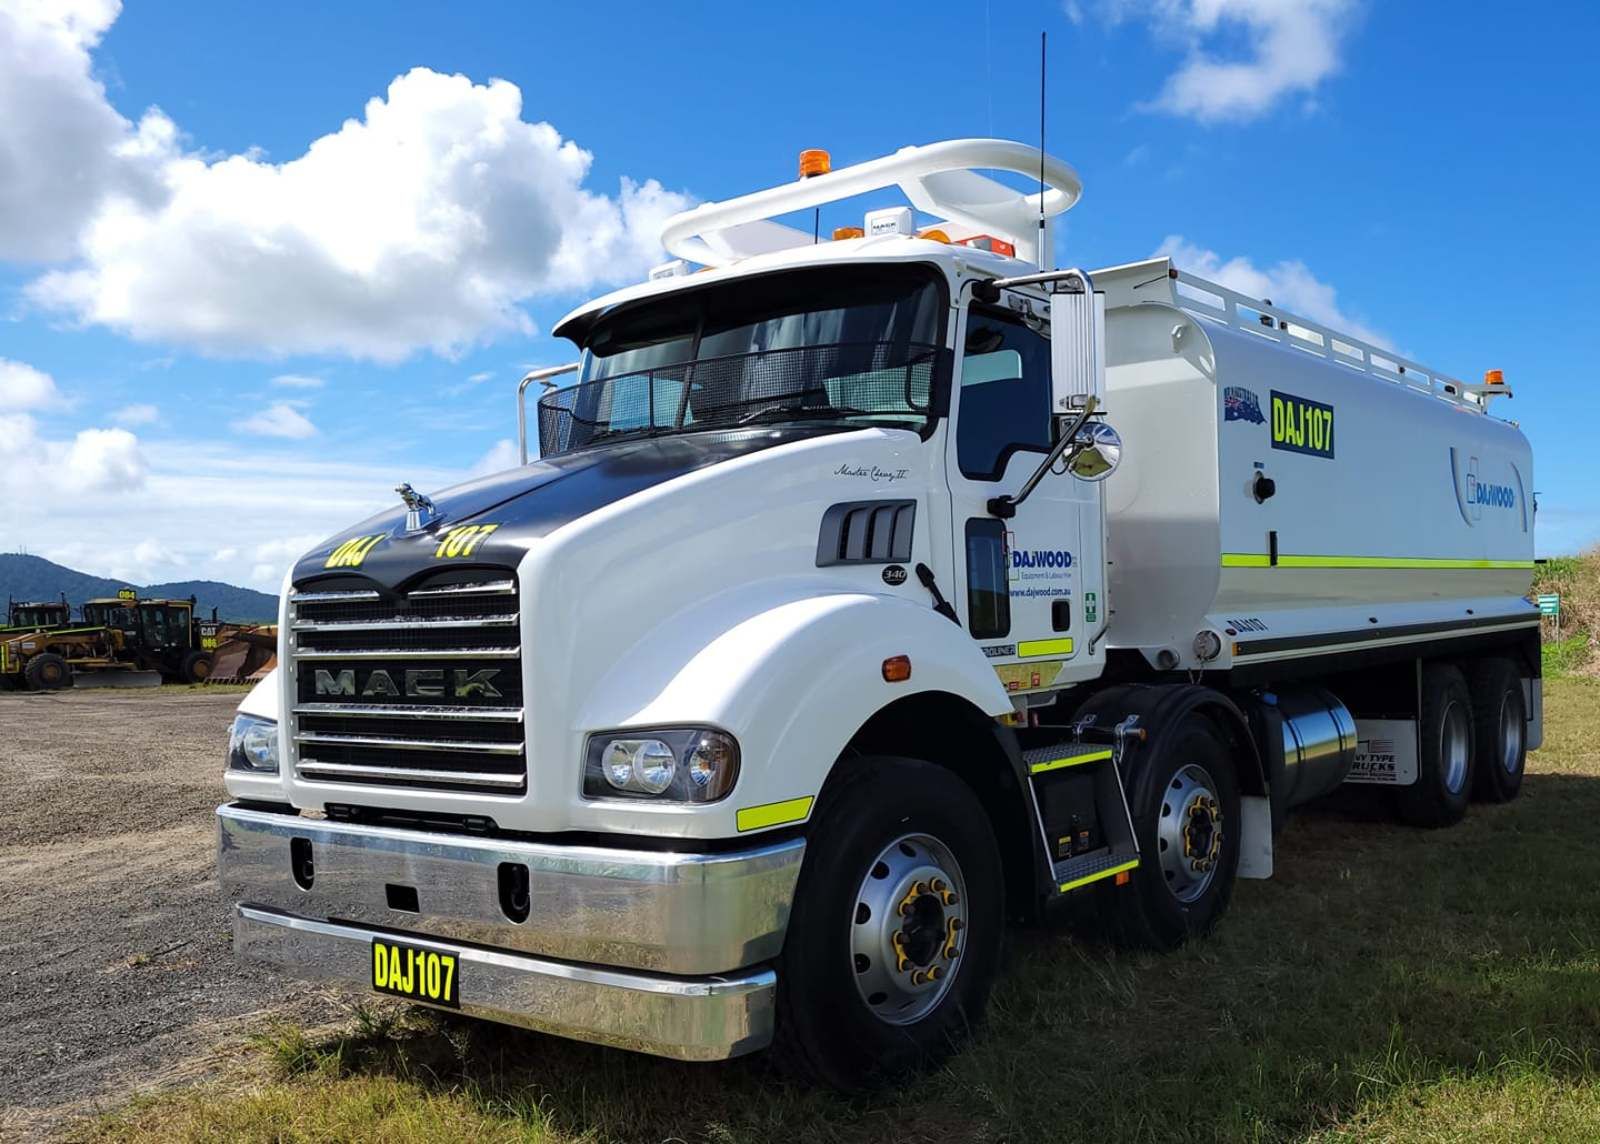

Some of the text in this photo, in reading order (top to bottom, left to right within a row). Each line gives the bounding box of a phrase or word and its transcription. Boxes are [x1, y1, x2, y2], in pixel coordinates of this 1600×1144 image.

[1273, 397, 1332, 451] DAJ107
[325, 524, 499, 568] DAJ 107
[884, 570, 906, 579] 340
[201, 626, 216, 636] CAT
[315, 669, 503, 697] MACK
[1352, 762, 1395, 771] RUCKS
[1369, 754, 1395, 762] TYPE
[374, 943, 454, 1001] DAJ107
